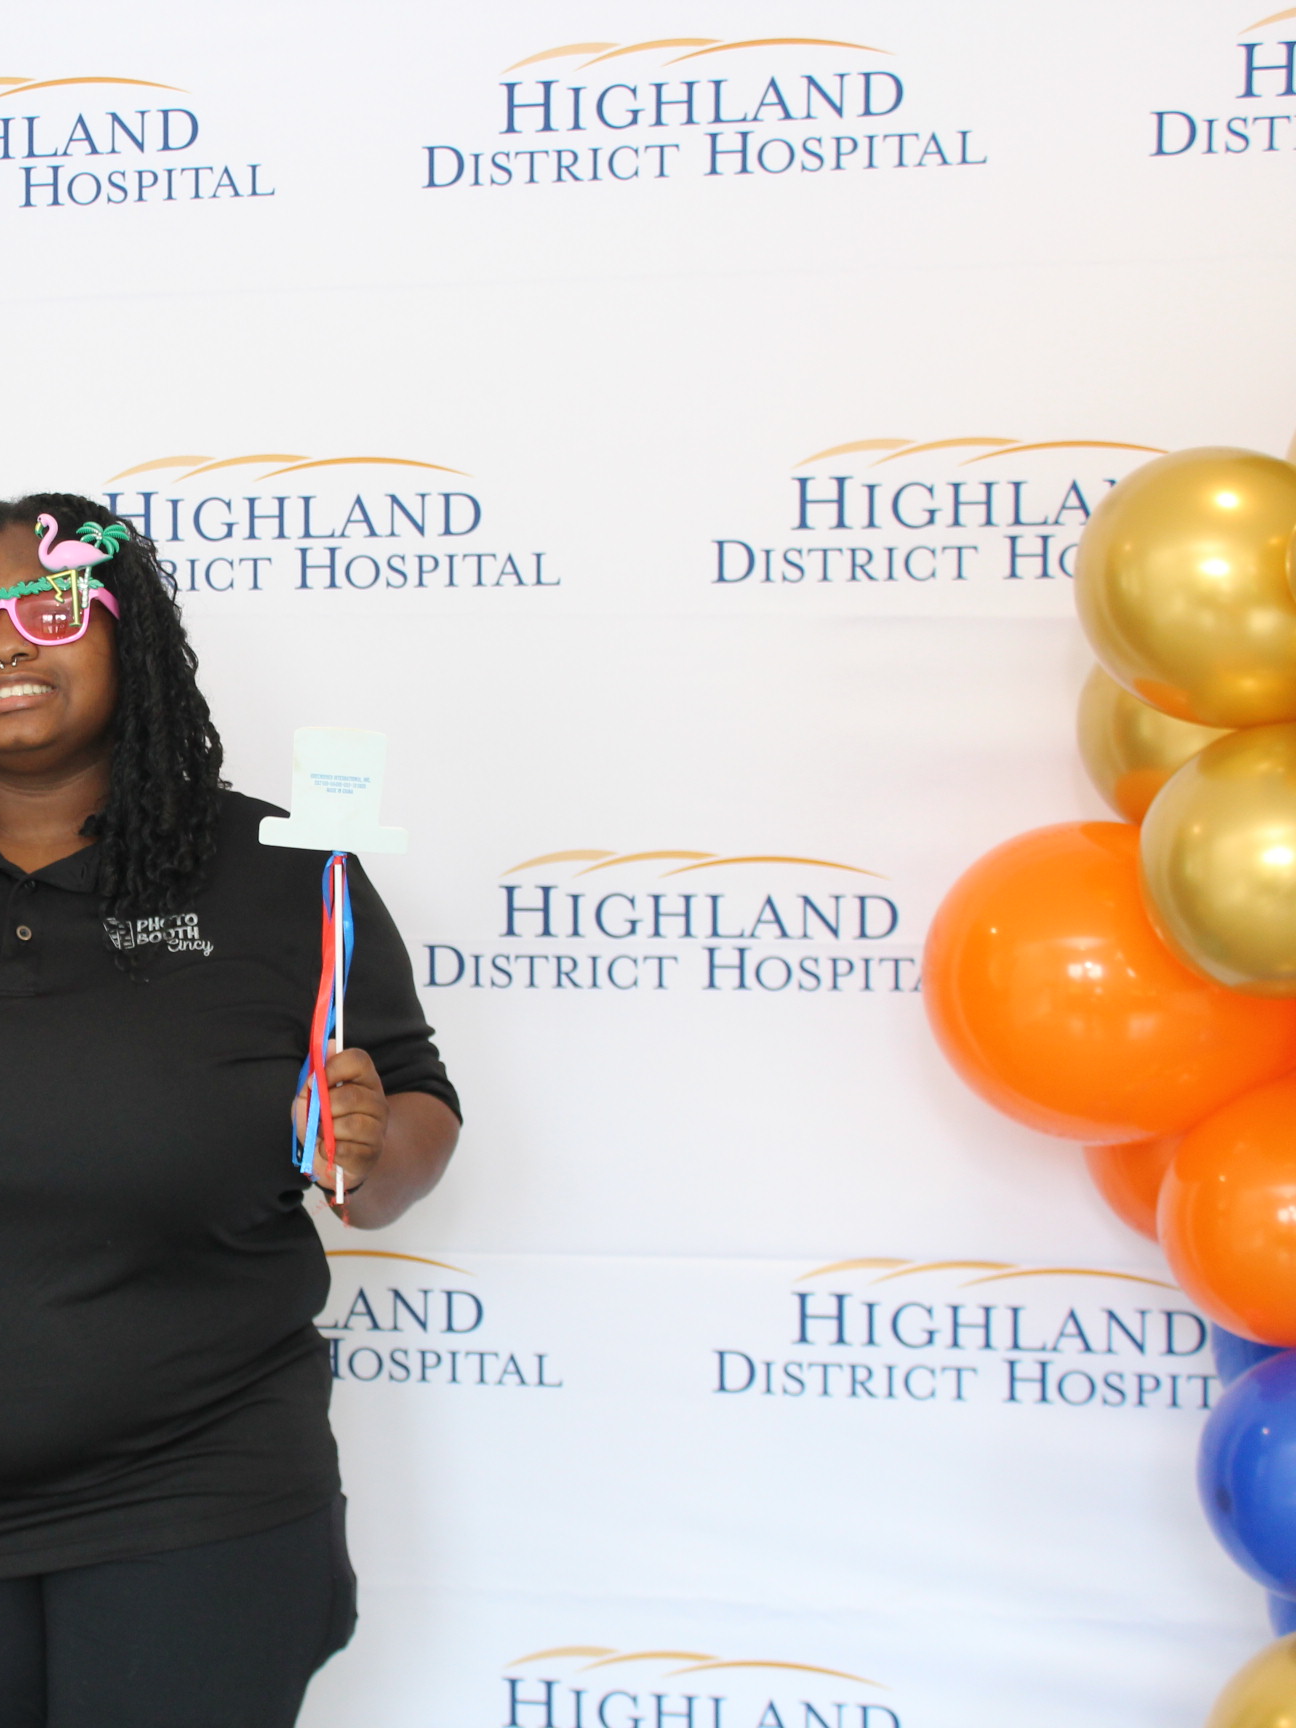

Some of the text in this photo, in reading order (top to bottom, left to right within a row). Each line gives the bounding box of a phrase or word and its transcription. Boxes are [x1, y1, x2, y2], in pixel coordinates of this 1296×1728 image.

[498, 69, 906, 135] HIGHLAND
[421, 128, 989, 189] DISTRICT HOSPITAL
[1149, 109, 1296, 158] DIST
[17, 162, 277, 211] HOSPITAL
[101, 490, 483, 544] HIGHLAND
[792, 478, 1118, 531] HIGHLA
[293, 545, 562, 592] HOSPITAL
[712, 538, 980, 585] DISTRICT
[499, 883, 901, 941] HIGHLAND
[423, 942, 680, 992] DISTRICT
[792, 1290, 1209, 1359] HIGHLAND
[712, 1348, 980, 1403] DISTRICT
